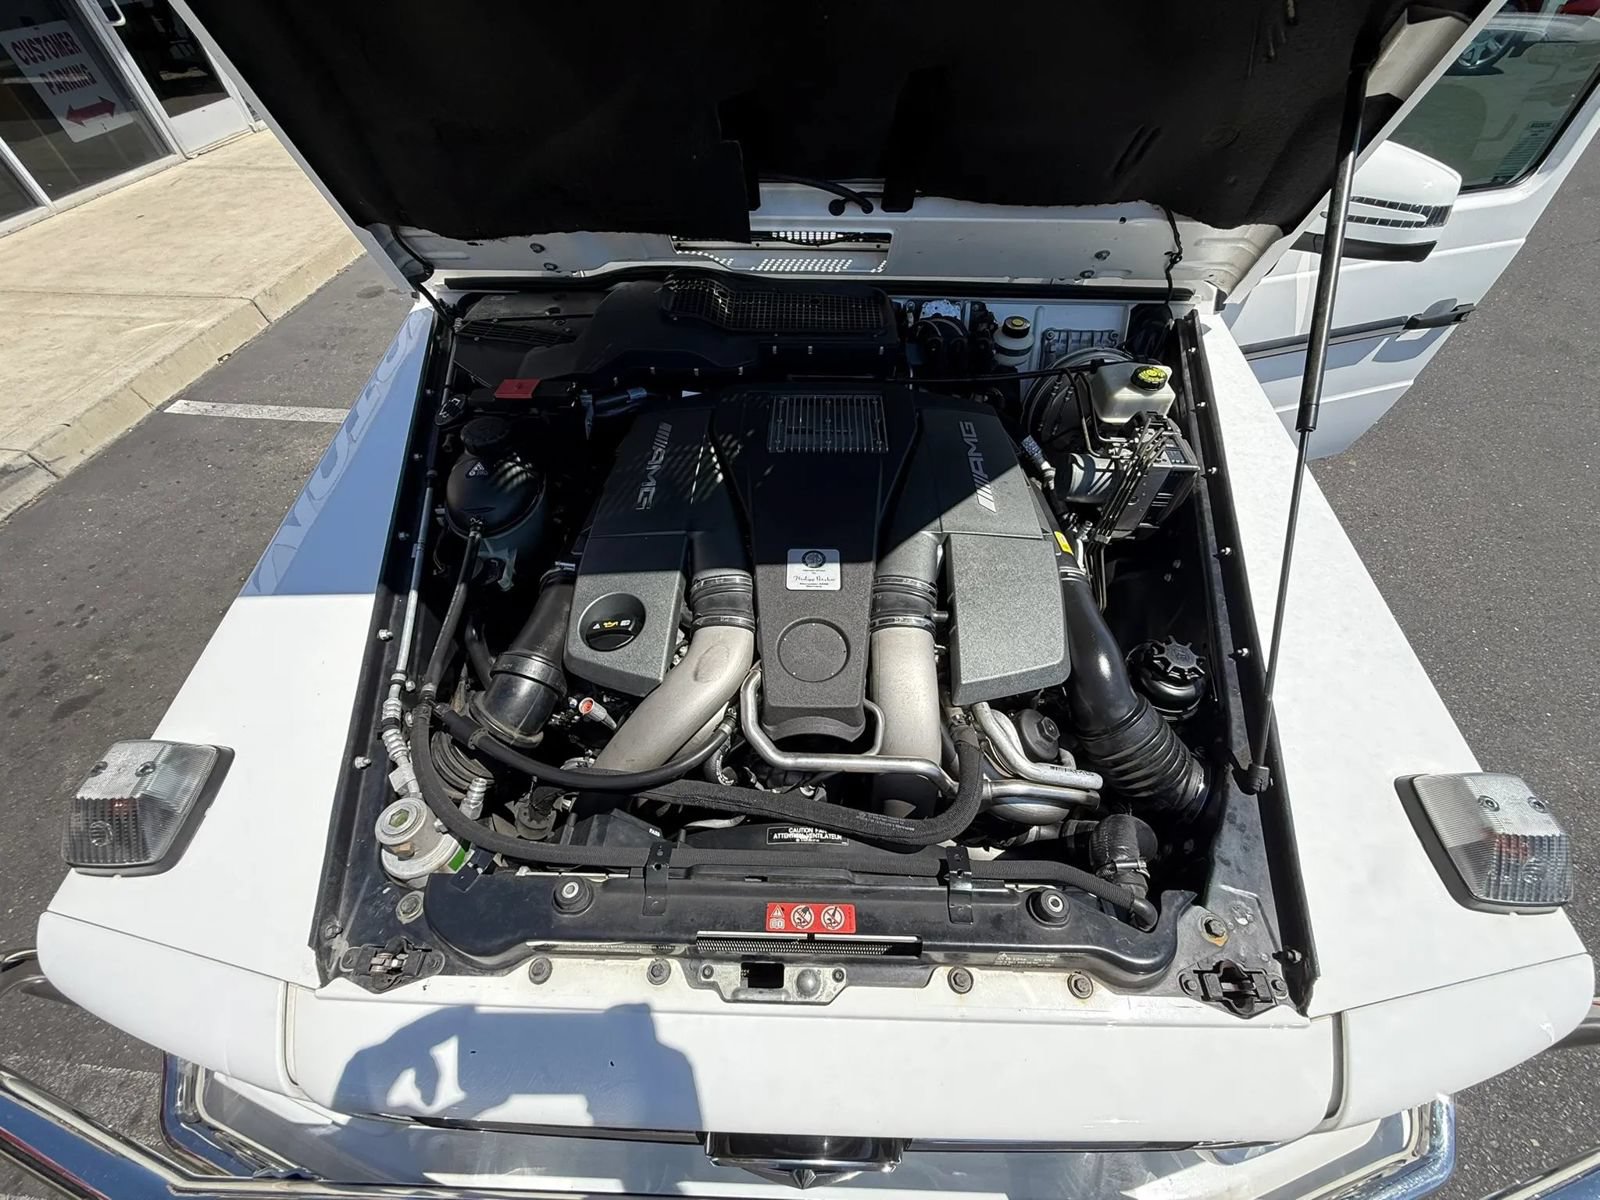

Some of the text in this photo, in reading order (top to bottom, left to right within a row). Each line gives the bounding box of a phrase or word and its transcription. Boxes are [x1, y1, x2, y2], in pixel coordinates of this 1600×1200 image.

[11, 31, 83, 66] CUSTOMER
[40, 63, 98, 96] PARKING
[635, 436, 668, 510] AMG
[959, 420, 990, 490] AMG
